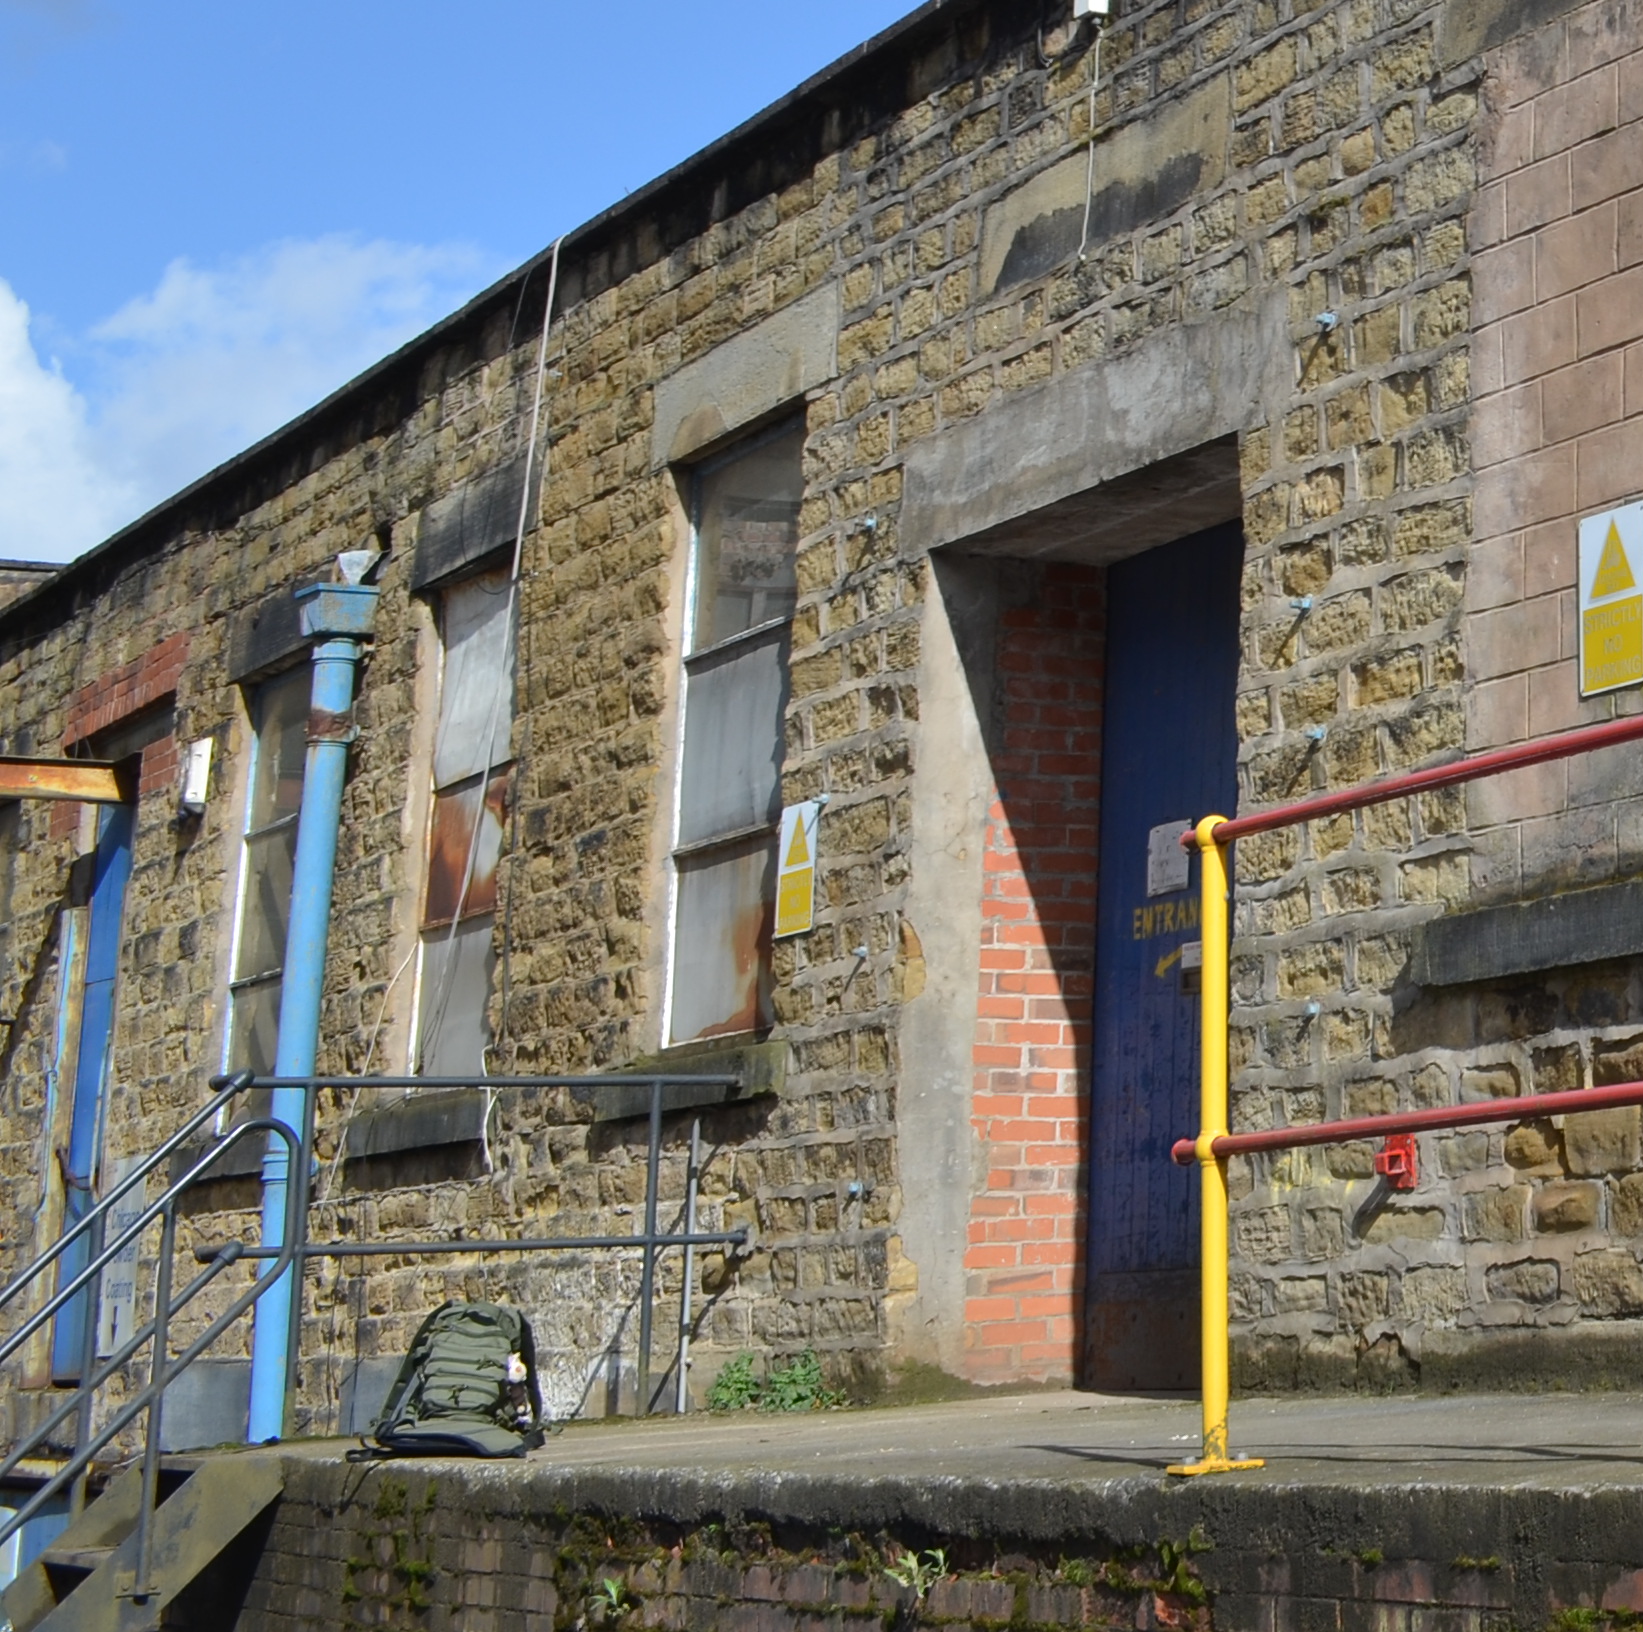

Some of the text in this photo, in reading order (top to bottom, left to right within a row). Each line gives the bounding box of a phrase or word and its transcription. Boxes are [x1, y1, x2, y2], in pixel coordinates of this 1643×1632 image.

[1584, 601, 1642, 635] STRICTLY
[1603, 633, 1623, 655] NO
[1585, 654, 1641, 685] PARKING
[1133, 897, 1203, 940] ENTRAN
